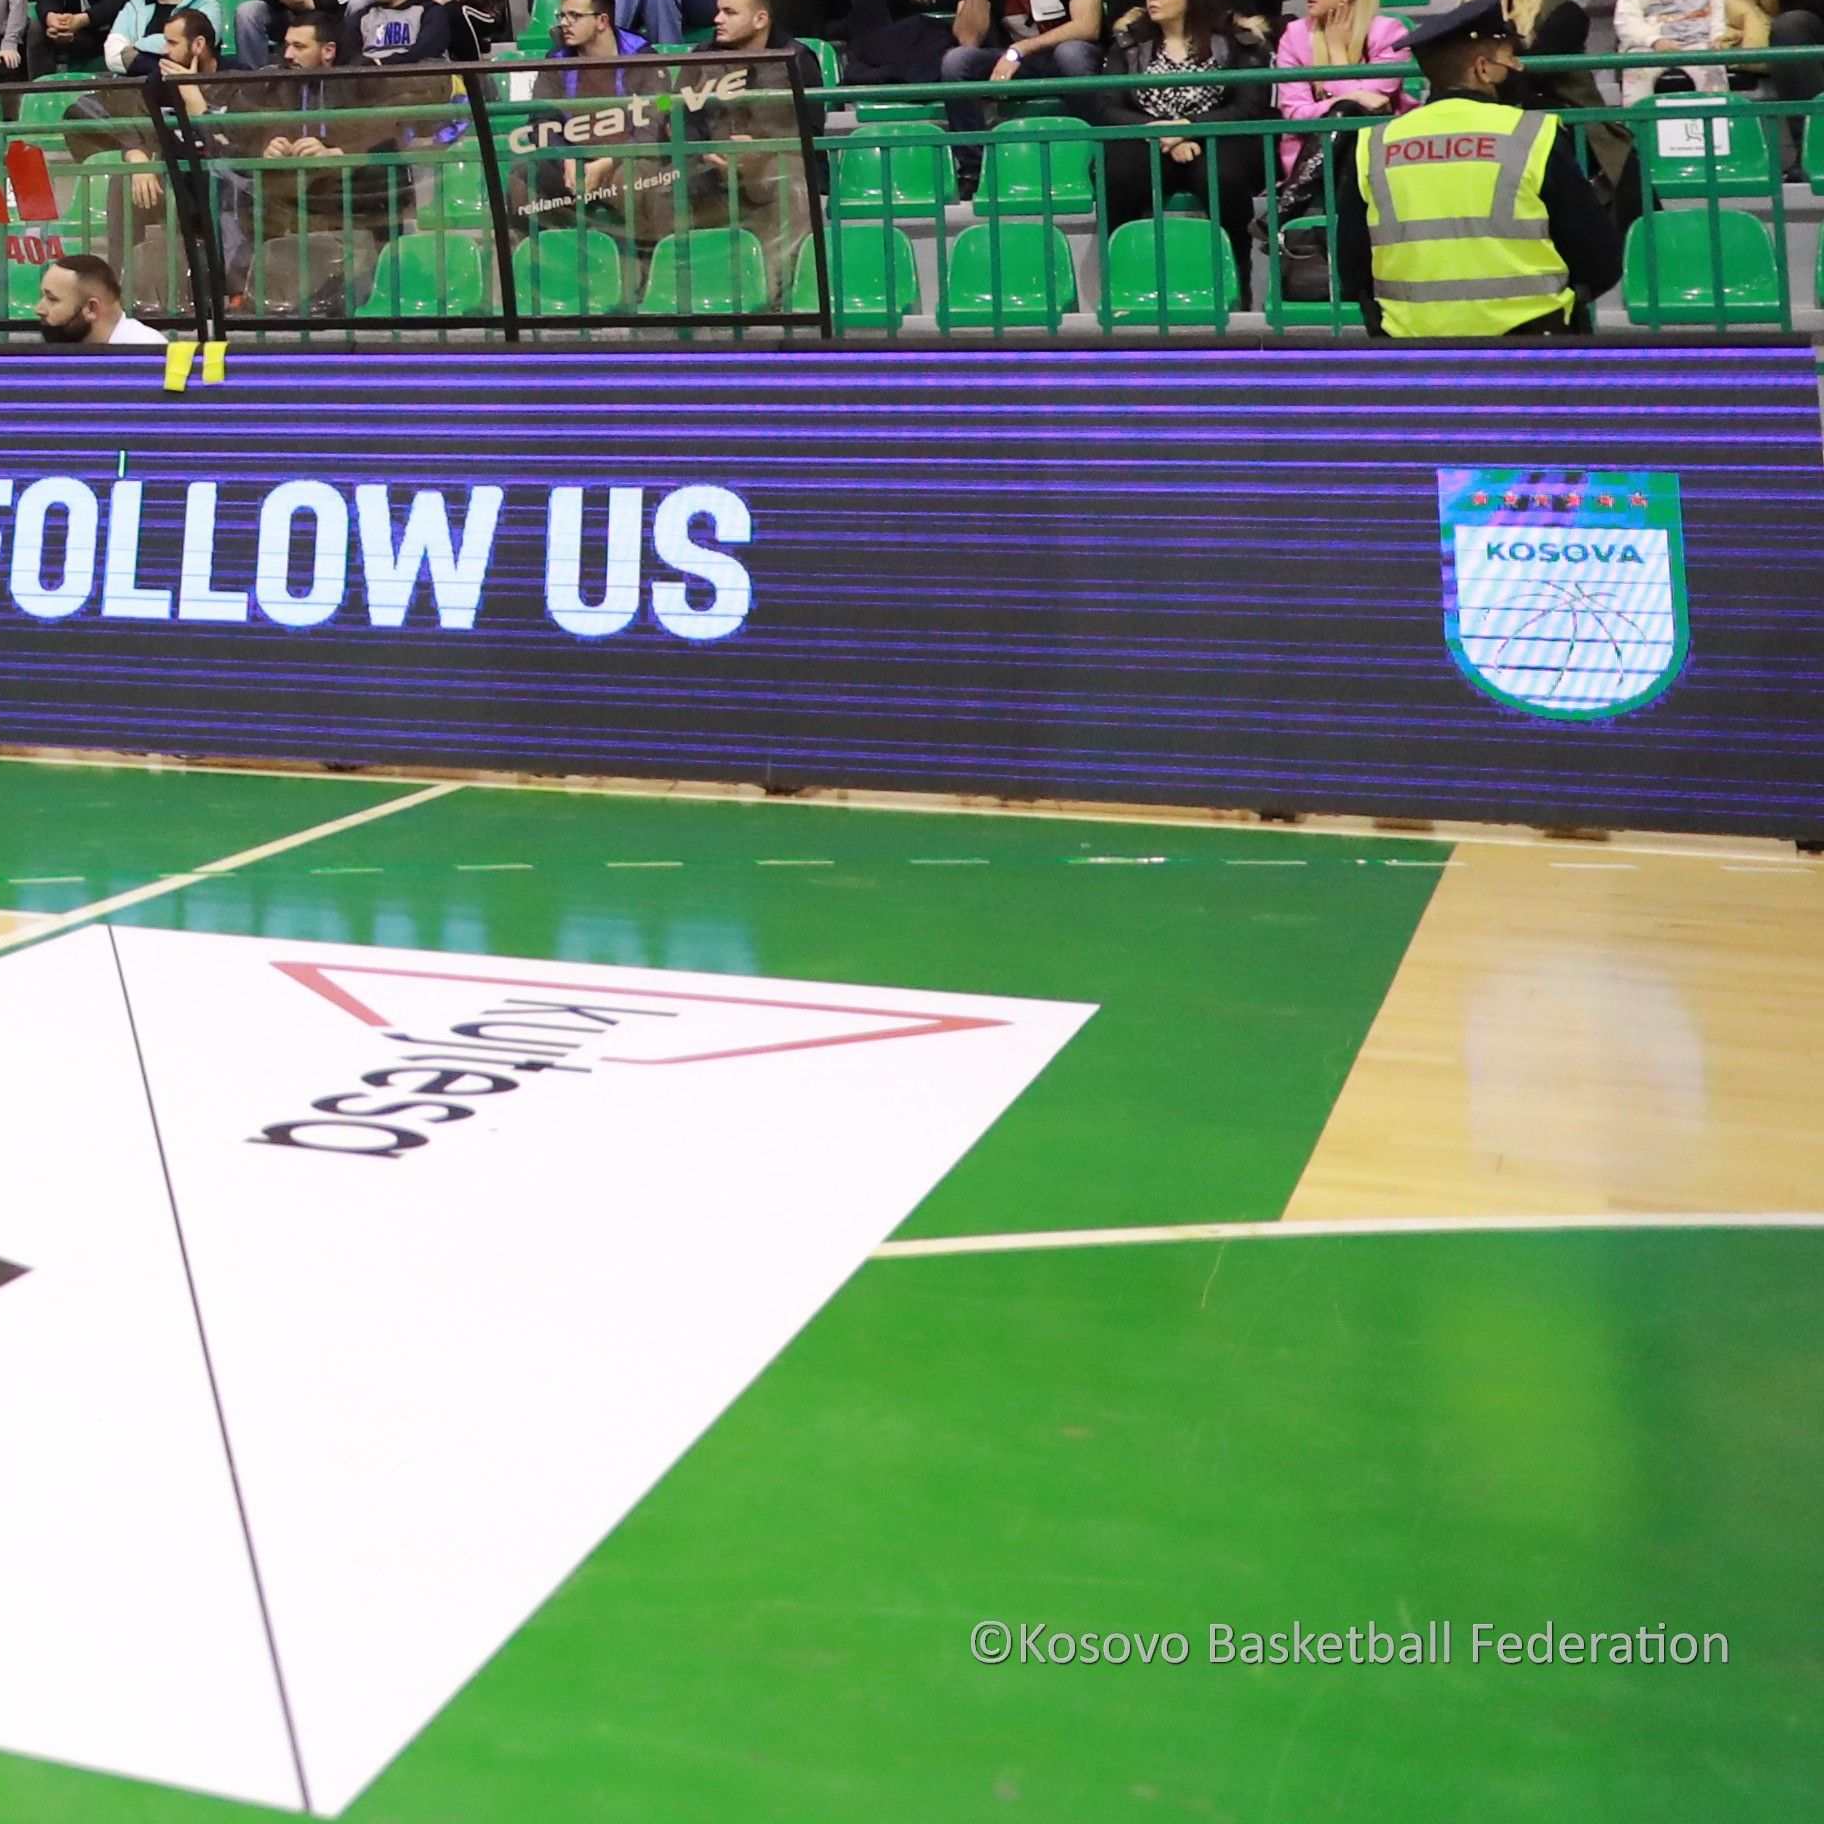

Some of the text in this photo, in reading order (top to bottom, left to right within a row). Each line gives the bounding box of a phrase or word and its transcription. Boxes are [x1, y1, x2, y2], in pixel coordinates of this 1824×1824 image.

[384, 21, 411, 45] NBA
[1384, 136, 1497, 166] POLICE
[518, 169, 681, 216] reklama print design
[544, 484, 752, 641] US
[1485, 540, 1645, 566] KOSOVA
